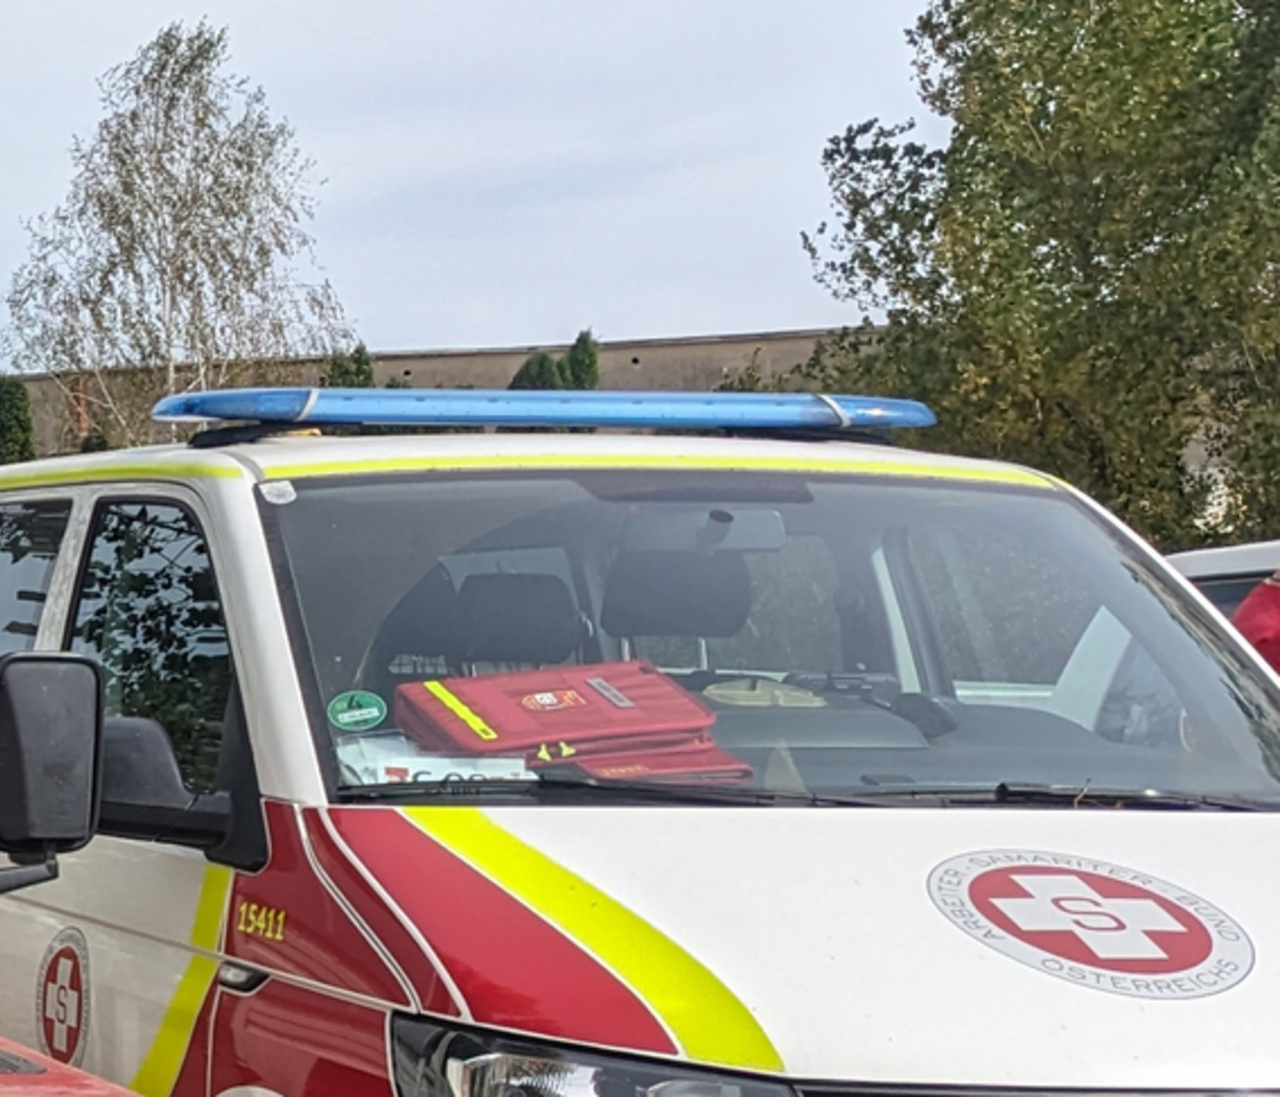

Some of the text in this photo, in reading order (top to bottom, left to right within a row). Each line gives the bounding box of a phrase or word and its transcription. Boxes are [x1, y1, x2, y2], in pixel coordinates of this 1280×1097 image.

[237, 901, 287, 941] 15411
[1050, 896, 1128, 932] S
[55, 985, 69, 1026] S
